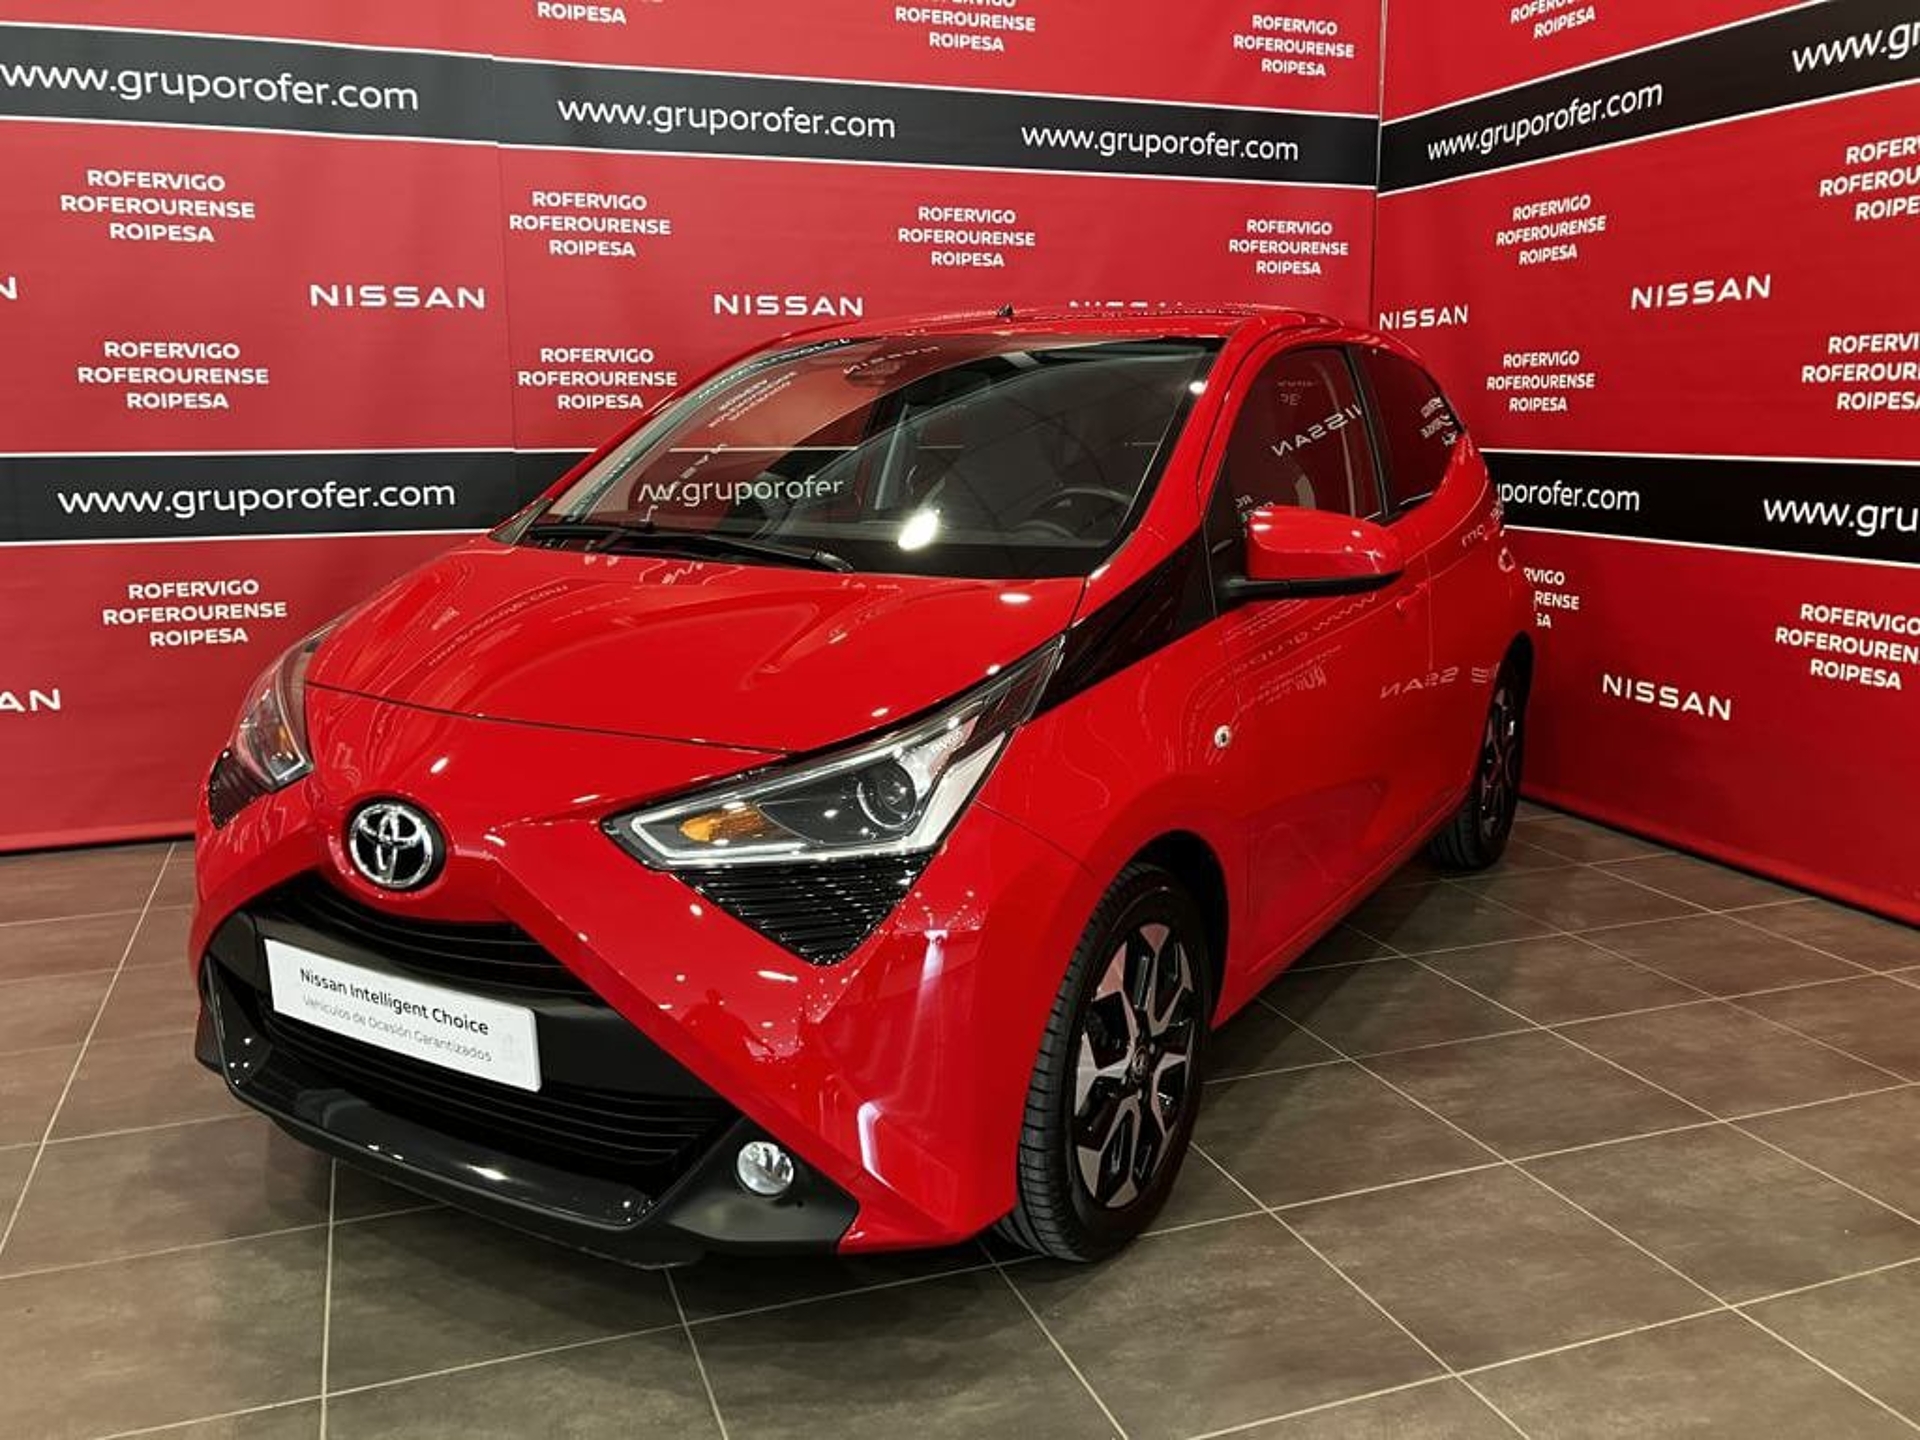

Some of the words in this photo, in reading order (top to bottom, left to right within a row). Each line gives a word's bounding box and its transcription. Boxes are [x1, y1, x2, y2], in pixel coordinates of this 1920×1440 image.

[538, 2, 626, 23] ROIPESA
[896, 7, 1035, 31] ROFEROURENSE
[1534, 7, 1595, 38] ROIPESA
[1253, 15, 1337, 35] ROFERVIGO
[930, 32, 1003, 51] ROIPESA
[1234, 35, 1353, 58] ROFEROURENSE
[1262, 58, 1326, 76] ROIPESA
[0, 64, 418, 110] www.gruporofer.com
[557, 98, 894, 139] www.gruporofer.com
[1428, 84, 1662, 160] www.gruporofer.com
[1022, 127, 1298, 160] www.gruporofer.com
[1846, 135, 1920, 164] ROFER
[88, 170, 225, 191] ROFERVIGO
[61, 195, 255, 218] ROFEROURENSE
[533, 191, 647, 210] ROFERVIGO
[1513, 195, 1590, 221] ROFERVIGO
[510, 215, 670, 234] ROFEROURENSE
[919, 207, 1015, 223] ROFERVIGO
[110, 223, 214, 242] ROIPESA
[899, 228, 1035, 246] ROFEROURENSE
[1247, 220, 1332, 235] ROFERVIGO
[1497, 216, 1606, 245] ROFEROURENSE
[550, 240, 635, 256] ROIPESA
[1230, 240, 1348, 255] ROFEROURENSE
[1519, 244, 1577, 264] ROIPESA
[932, 251, 1004, 266] ROIPESA
[1257, 261, 1321, 274] ROIPESA
[311, 285, 484, 308] NISSAN
[1632, 275, 1770, 309] NISSAN
[715, 295, 862, 316] NISSAN
[1380, 306, 1467, 330] NISSAN
[105, 342, 240, 358] ROFERVIGO
[1829, 333, 1920, 353] ROFERVI
[541, 348, 653, 363] ROFERVIGO
[1503, 351, 1579, 367] ROFERVIGO
[78, 367, 268, 384] ROFEROURENSE
[519, 371, 677, 386] ROFEROURENSE
[1487, 373, 1594, 390] ROFEROURENSE
[1802, 362, 1920, 382] ROFEROUR
[127, 393, 228, 408] ROIPESA
[558, 394, 643, 409] ROIPESA
[1509, 397, 1567, 411] ROIPESA
[58, 481, 454, 518] www.gruporofer.com
[637, 474, 844, 507] w.gruporofer
[1497, 480, 1639, 510] porofer.com
[1764, 500, 1918, 536] www.gru
[129, 579, 259, 599] ROFERVIGO
[1534, 591, 1579, 610] RENSE
[103, 602, 287, 624] ROFEROURENSE
[1801, 604, 1920, 635] ROFERVIGO
[150, 628, 248, 646] ROIPESA
[1776, 627, 1920, 664] ROFEROUREN
[1811, 660, 1901, 690] ROIPESA
[0, 689, 60, 711] AN
[1603, 674, 1730, 720] NISSAN
[299, 968, 348, 996] Nissan
[350, 983, 429, 1019] Intelligent
[432, 1007, 489, 1036] Choice
